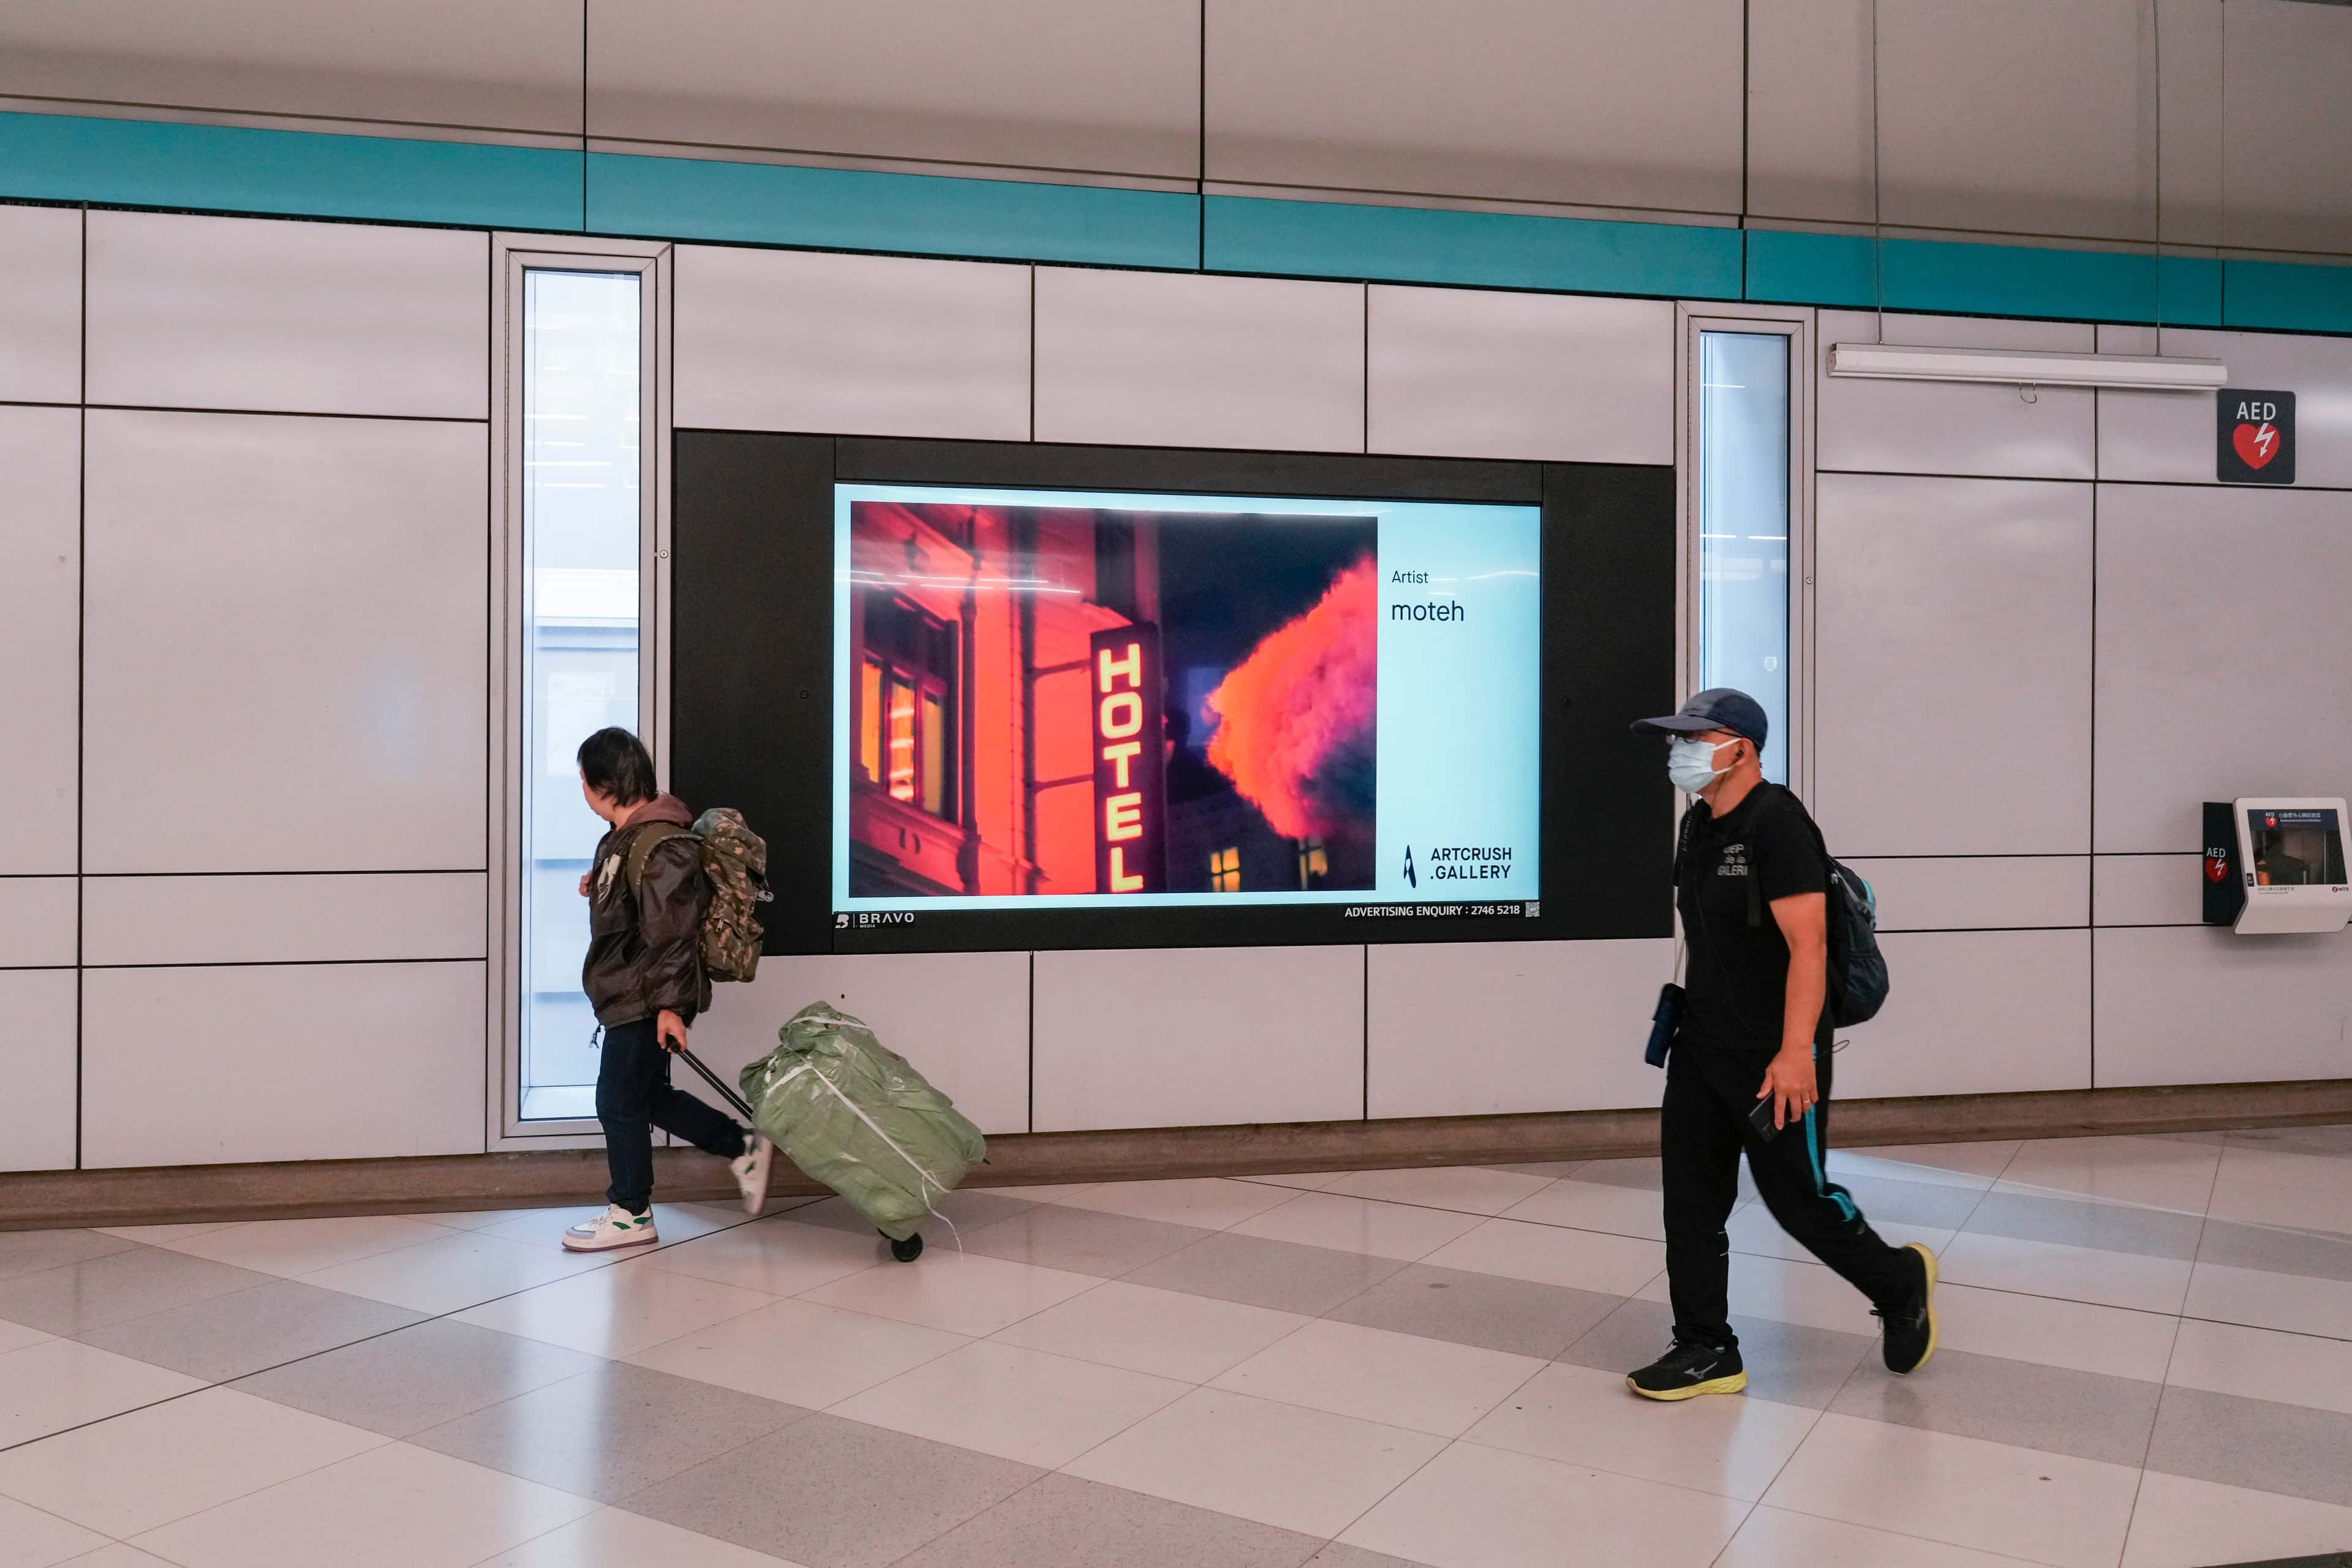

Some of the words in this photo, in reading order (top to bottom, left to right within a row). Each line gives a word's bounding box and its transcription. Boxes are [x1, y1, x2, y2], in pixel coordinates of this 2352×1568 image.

[2236, 401, 2276, 420] AED
[1392, 570, 1429, 583] Artist
[1392, 600, 1464, 621] moteh
[1099, 643, 1144, 892] HOTEL
[1431, 847, 1512, 861] ARTCRUSH
[2206, 847, 2226, 858] AED
[1430, 865, 1511, 880] .GALLERY
[859, 913, 914, 924] BRAVO
[1345, 906, 1414, 918] ADVERTISING
[1417, 905, 1463, 918] ENQUIRY
[1471, 906, 1494, 915] 2746
[1497, 905, 1520, 914] 5218
